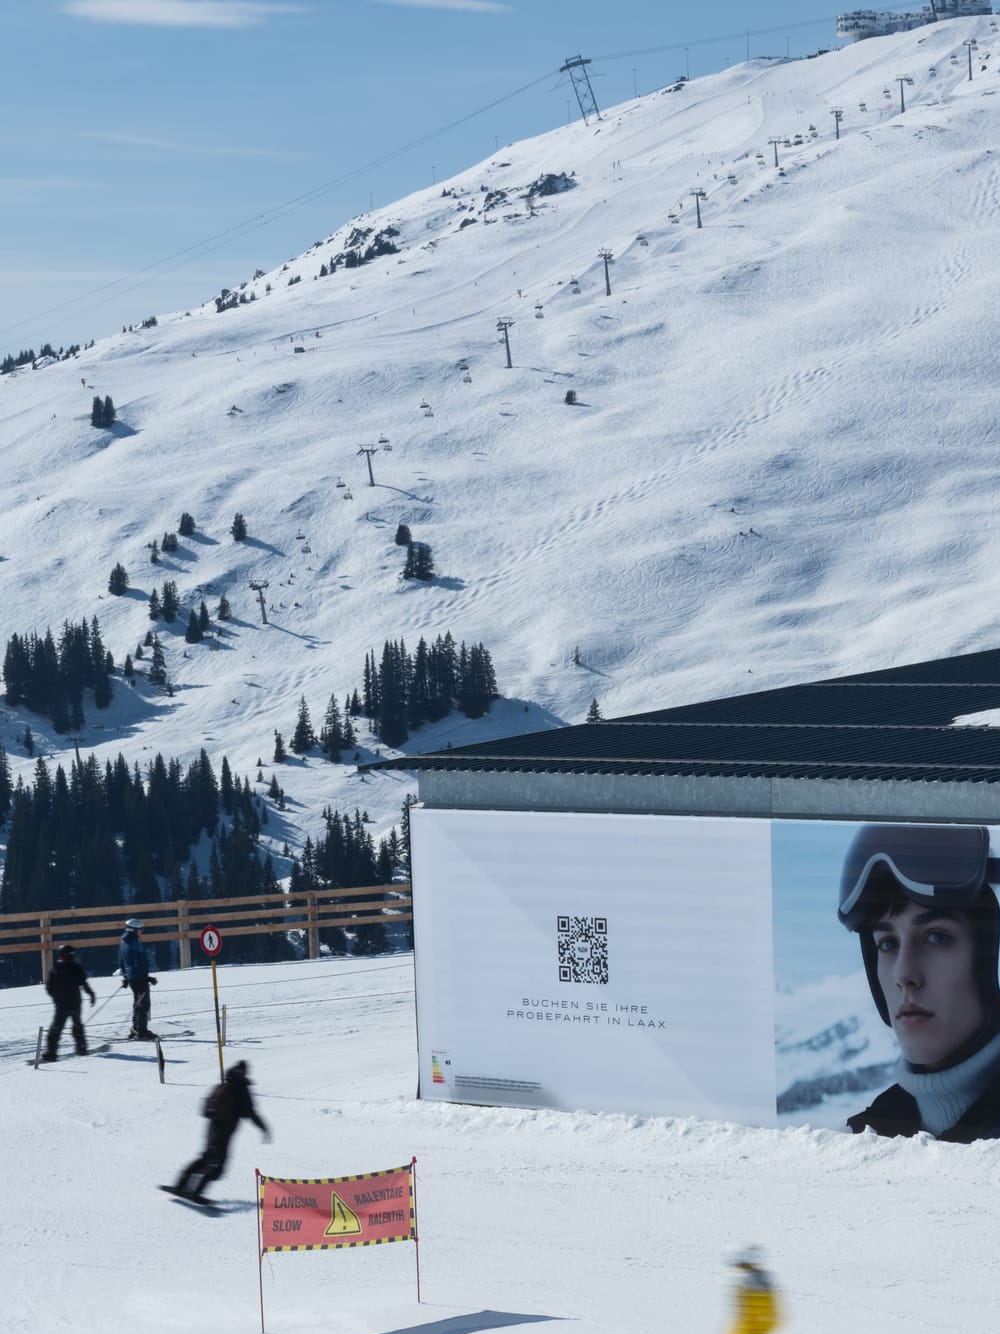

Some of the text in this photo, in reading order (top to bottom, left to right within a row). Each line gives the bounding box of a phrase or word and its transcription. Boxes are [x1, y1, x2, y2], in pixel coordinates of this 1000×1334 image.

[522, 998, 649, 1014] BUCHEN SIE IHRE
[507, 1010, 666, 1029] PROBEFAHRT IN LAAX
[272, 1219, 302, 1232] SLOW
